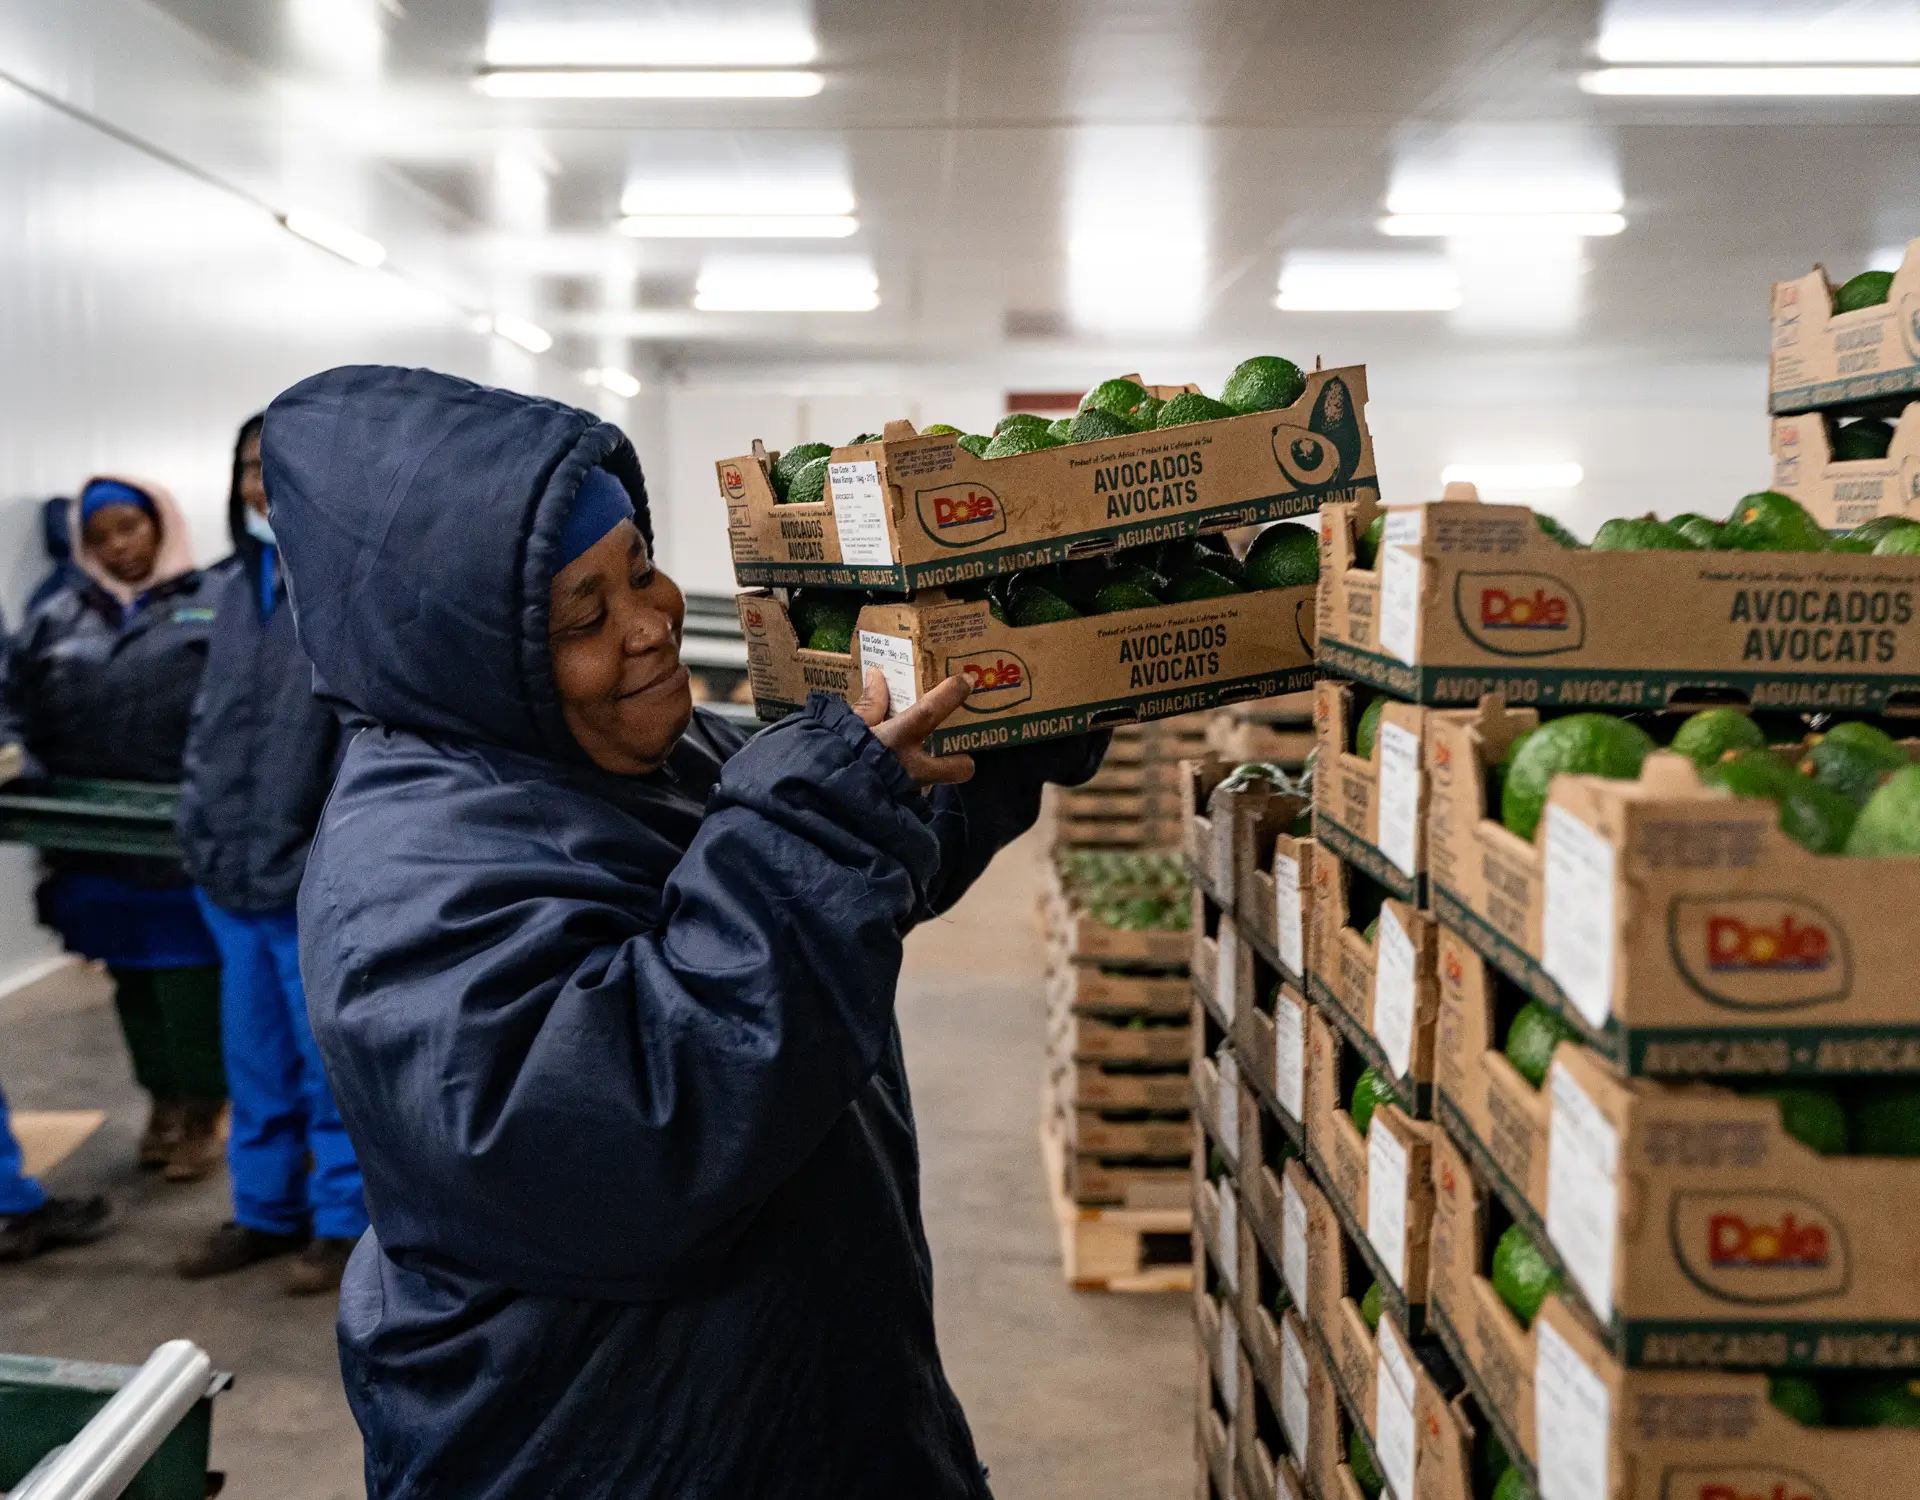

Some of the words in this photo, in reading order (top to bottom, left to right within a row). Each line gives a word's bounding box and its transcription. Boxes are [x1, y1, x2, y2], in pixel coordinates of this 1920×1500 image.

[1070, 458, 1092, 469] Product
[1100, 453, 1117, 463] South
[1118, 451, 1135, 459] Africa
[1141, 446, 1161, 455] Produit
[1202, 436, 1213, 444] Sud
[726, 470, 742, 486] Dole
[1094, 451, 1203, 494] AVOCADOS
[933, 492, 995, 524] Dole
[1107, 480, 1198, 519] AVOCATS
[781, 520, 824, 540] AVOCADOS
[916, 560, 984, 589] AVOCADO
[998, 548, 1051, 573] AVOCAT
[1117, 521, 1186, 549] AGUACATE
[1269, 494, 1316, 518] AVOCAT
[788, 541, 825, 561] AVOCATS
[832, 570, 852, 585] PALTA
[858, 569, 895, 585] AGUACATE
[1480, 588, 1568, 625] Dole
[1730, 589, 1913, 624] AVOCADOS
[1097, 630, 1119, 639] Product
[1127, 625, 1144, 634] South
[1145, 623, 1161, 631] Africa
[1228, 609, 1238, 618] Sud
[1119, 623, 1227, 663] AVOCADOS
[1743, 629, 1898, 662] AVOCATS
[803, 667, 848, 690] AVOCADOS
[963, 659, 1021, 688] Dole
[1130, 652, 1219, 689] AVOCATS
[1434, 678, 1539, 701] AVOCADO
[1559, 680, 1645, 703] AVOCAT
[1752, 682, 1867, 705] AGUACATE
[942, 726, 1009, 753] AVOCADO
[1021, 715, 1073, 739] AVOCAT
[1138, 691, 1205, 717] AGUACATE
[1707, 913, 1828, 964] Dole
[1709, 1213, 1828, 1261] Dole
